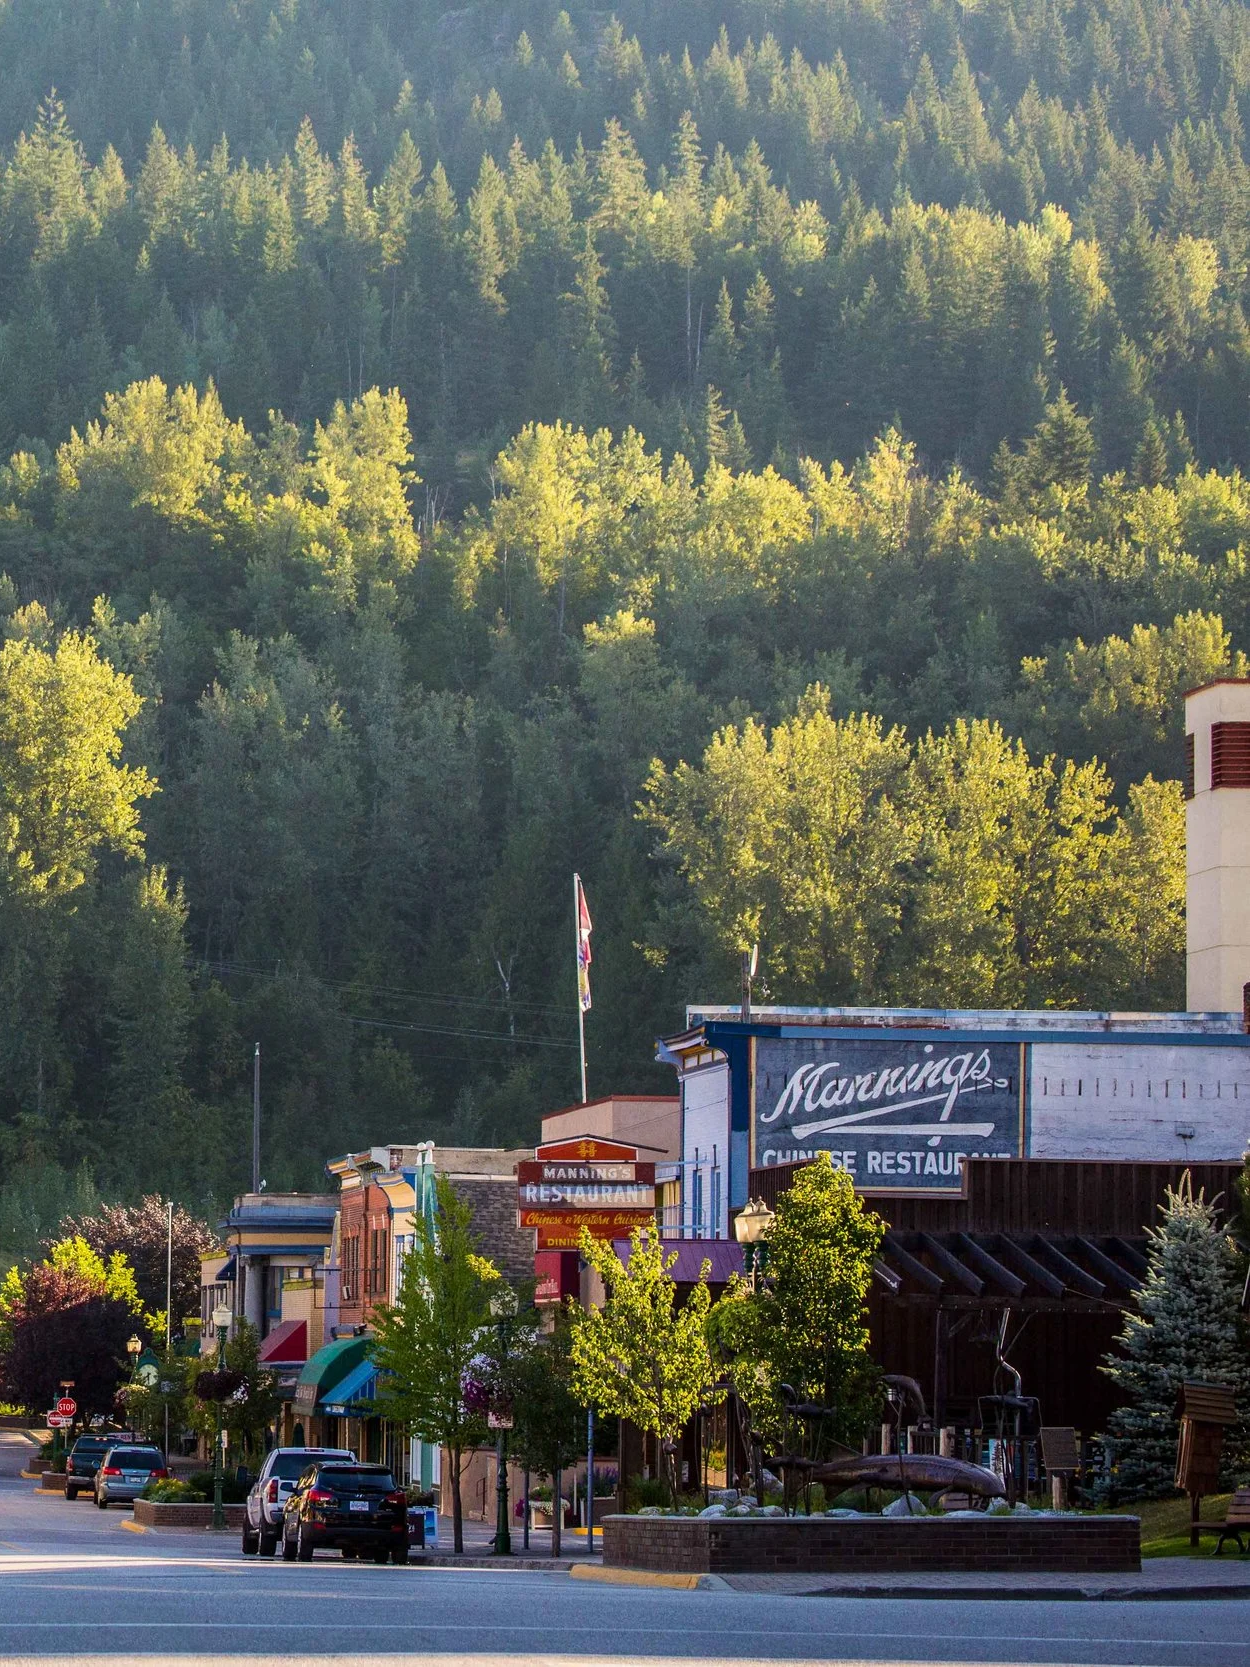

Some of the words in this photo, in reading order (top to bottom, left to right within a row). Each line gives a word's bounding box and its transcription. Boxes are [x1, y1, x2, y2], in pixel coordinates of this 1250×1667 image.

[760, 1044, 1008, 1147] Mannings
[543, 1166, 631, 1179] MANNING'S
[525, 1183, 650, 1203] RESTAURANT
[526, 1212, 563, 1225] Chinese
[573, 1213, 610, 1225] Western
[613, 1213, 650, 1225] Cuisine
[59, 1403, 75, 1411] STOP
